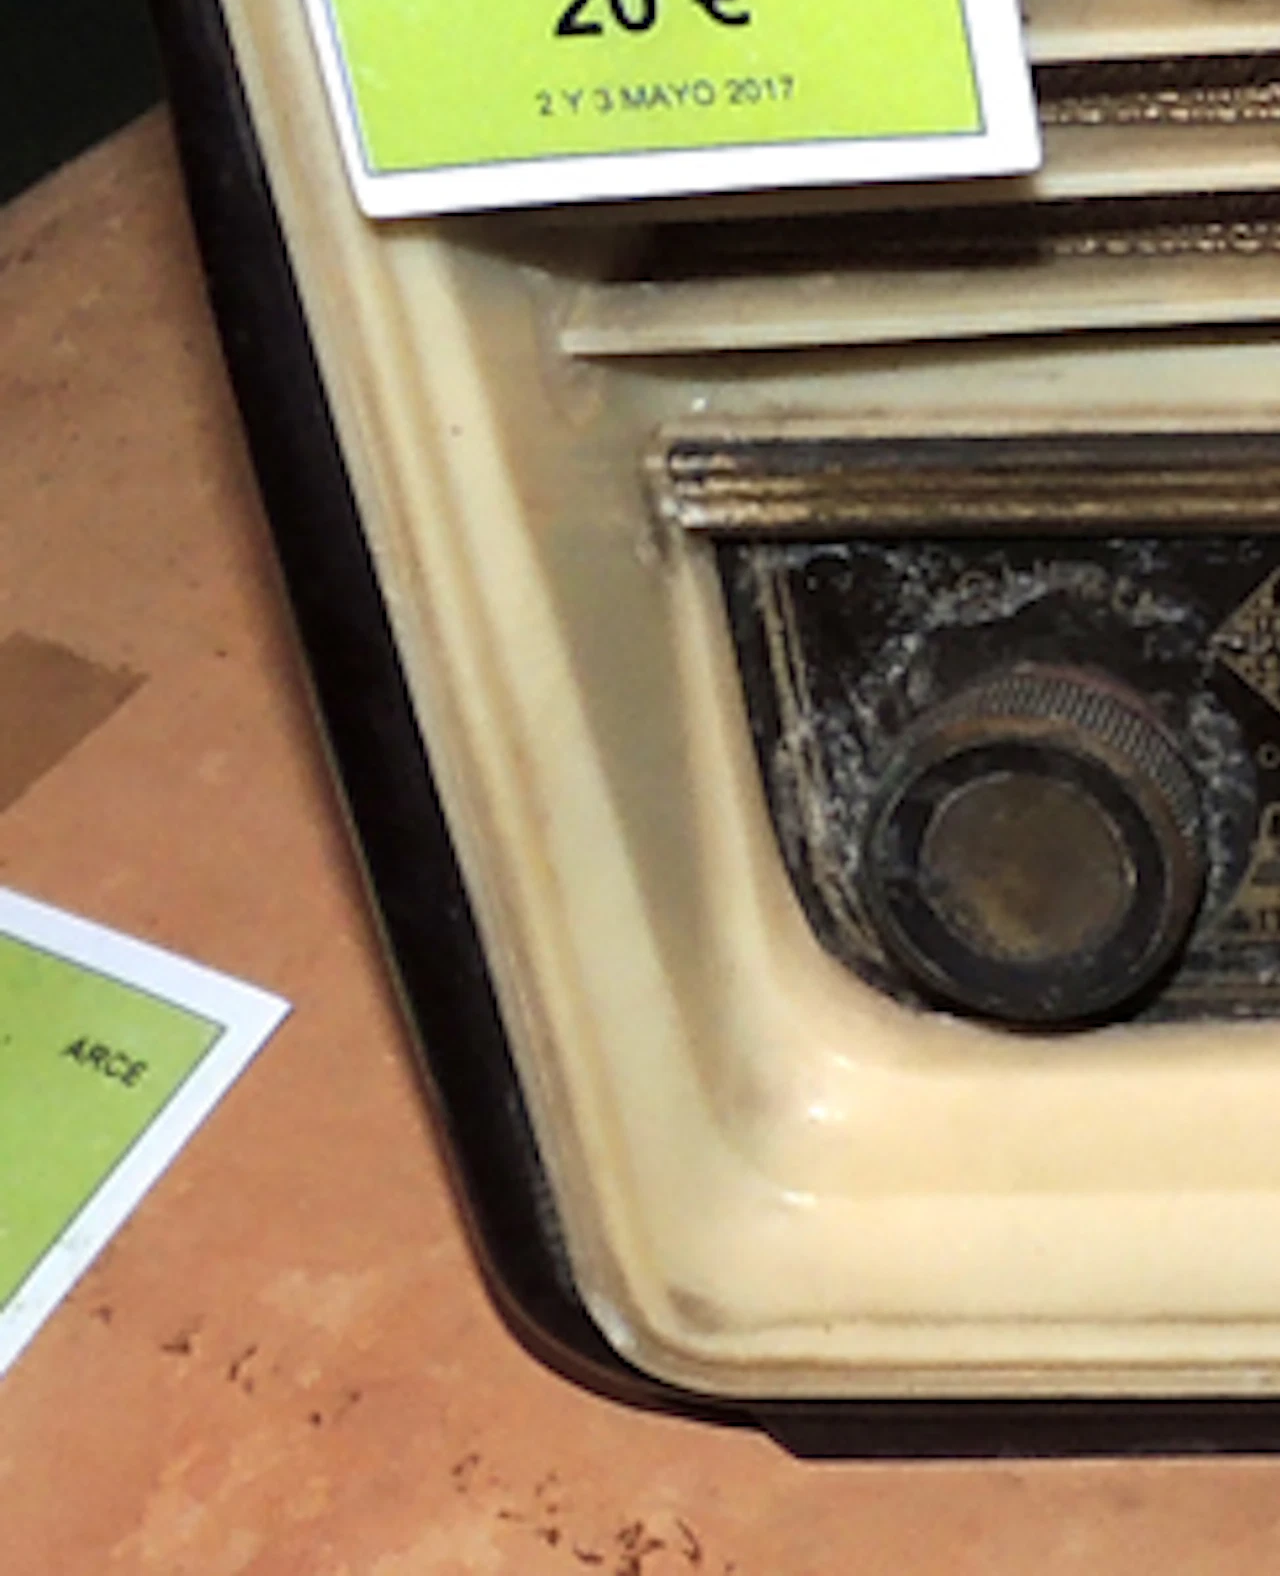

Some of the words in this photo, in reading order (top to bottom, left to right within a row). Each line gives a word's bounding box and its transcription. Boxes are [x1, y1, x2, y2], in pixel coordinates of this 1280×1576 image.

[535, 89, 553, 116] 2
[562, 88, 583, 113] Y
[592, 87, 614, 114] 3
[619, 77, 716, 110] MAYO
[725, 74, 796, 105] 2017
[59, 1034, 150, 1090] ARCE
